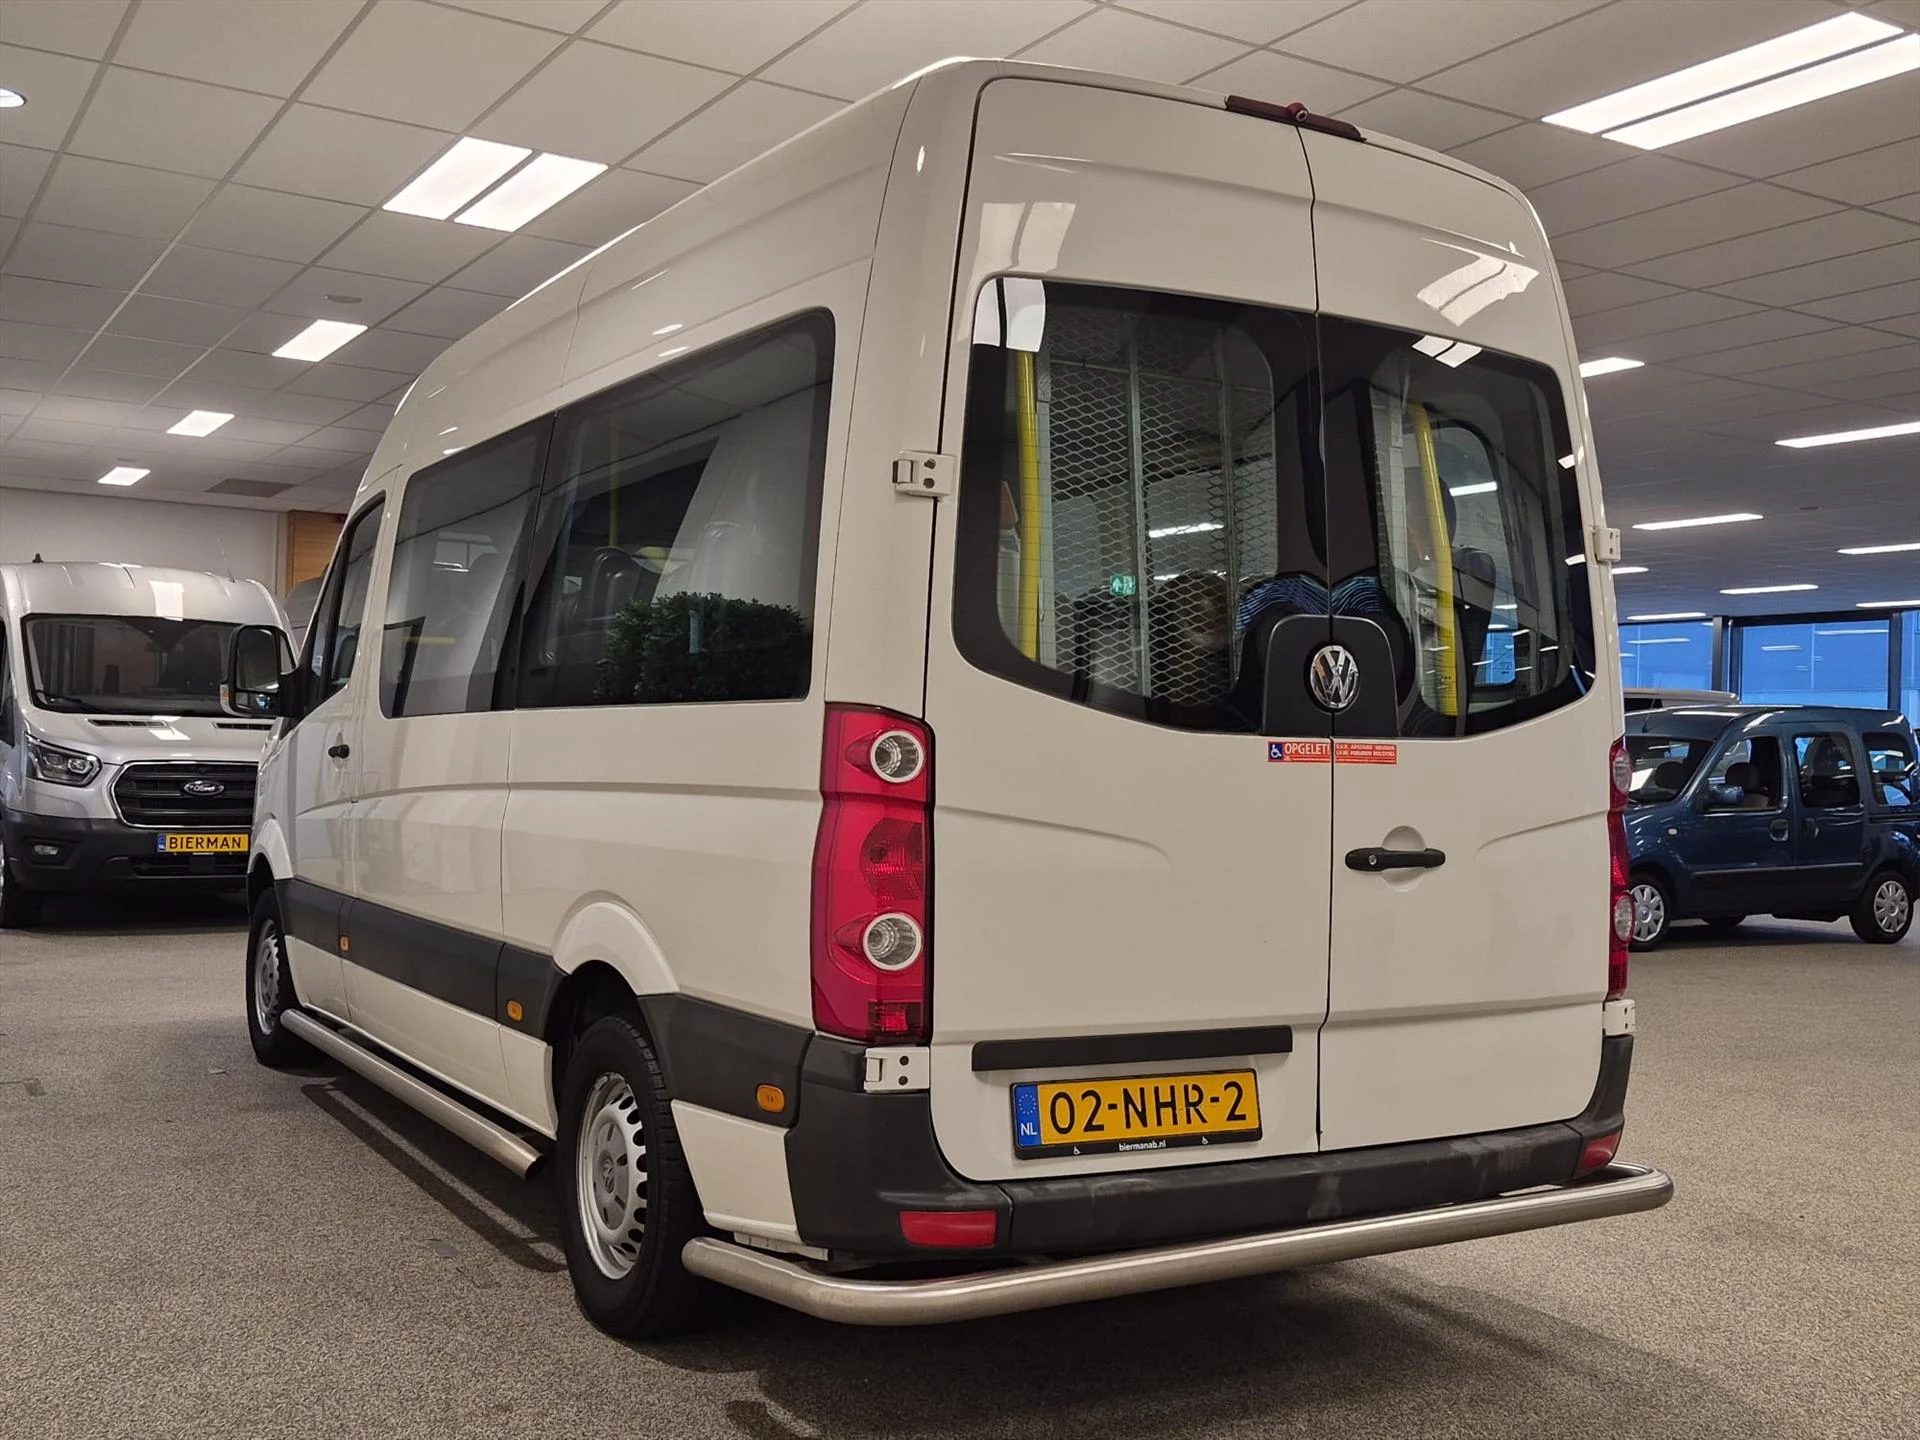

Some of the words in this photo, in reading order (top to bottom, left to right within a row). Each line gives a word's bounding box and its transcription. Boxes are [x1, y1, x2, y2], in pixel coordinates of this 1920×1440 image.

[1284, 742, 1330, 755] OPGELET!
[169, 836, 242, 850] BIERMAN
[1049, 1080, 1247, 1135] 02-NHR-2
[1020, 1122, 1038, 1137] NL
[1118, 1139, 1167, 1152] biermanab.nl
